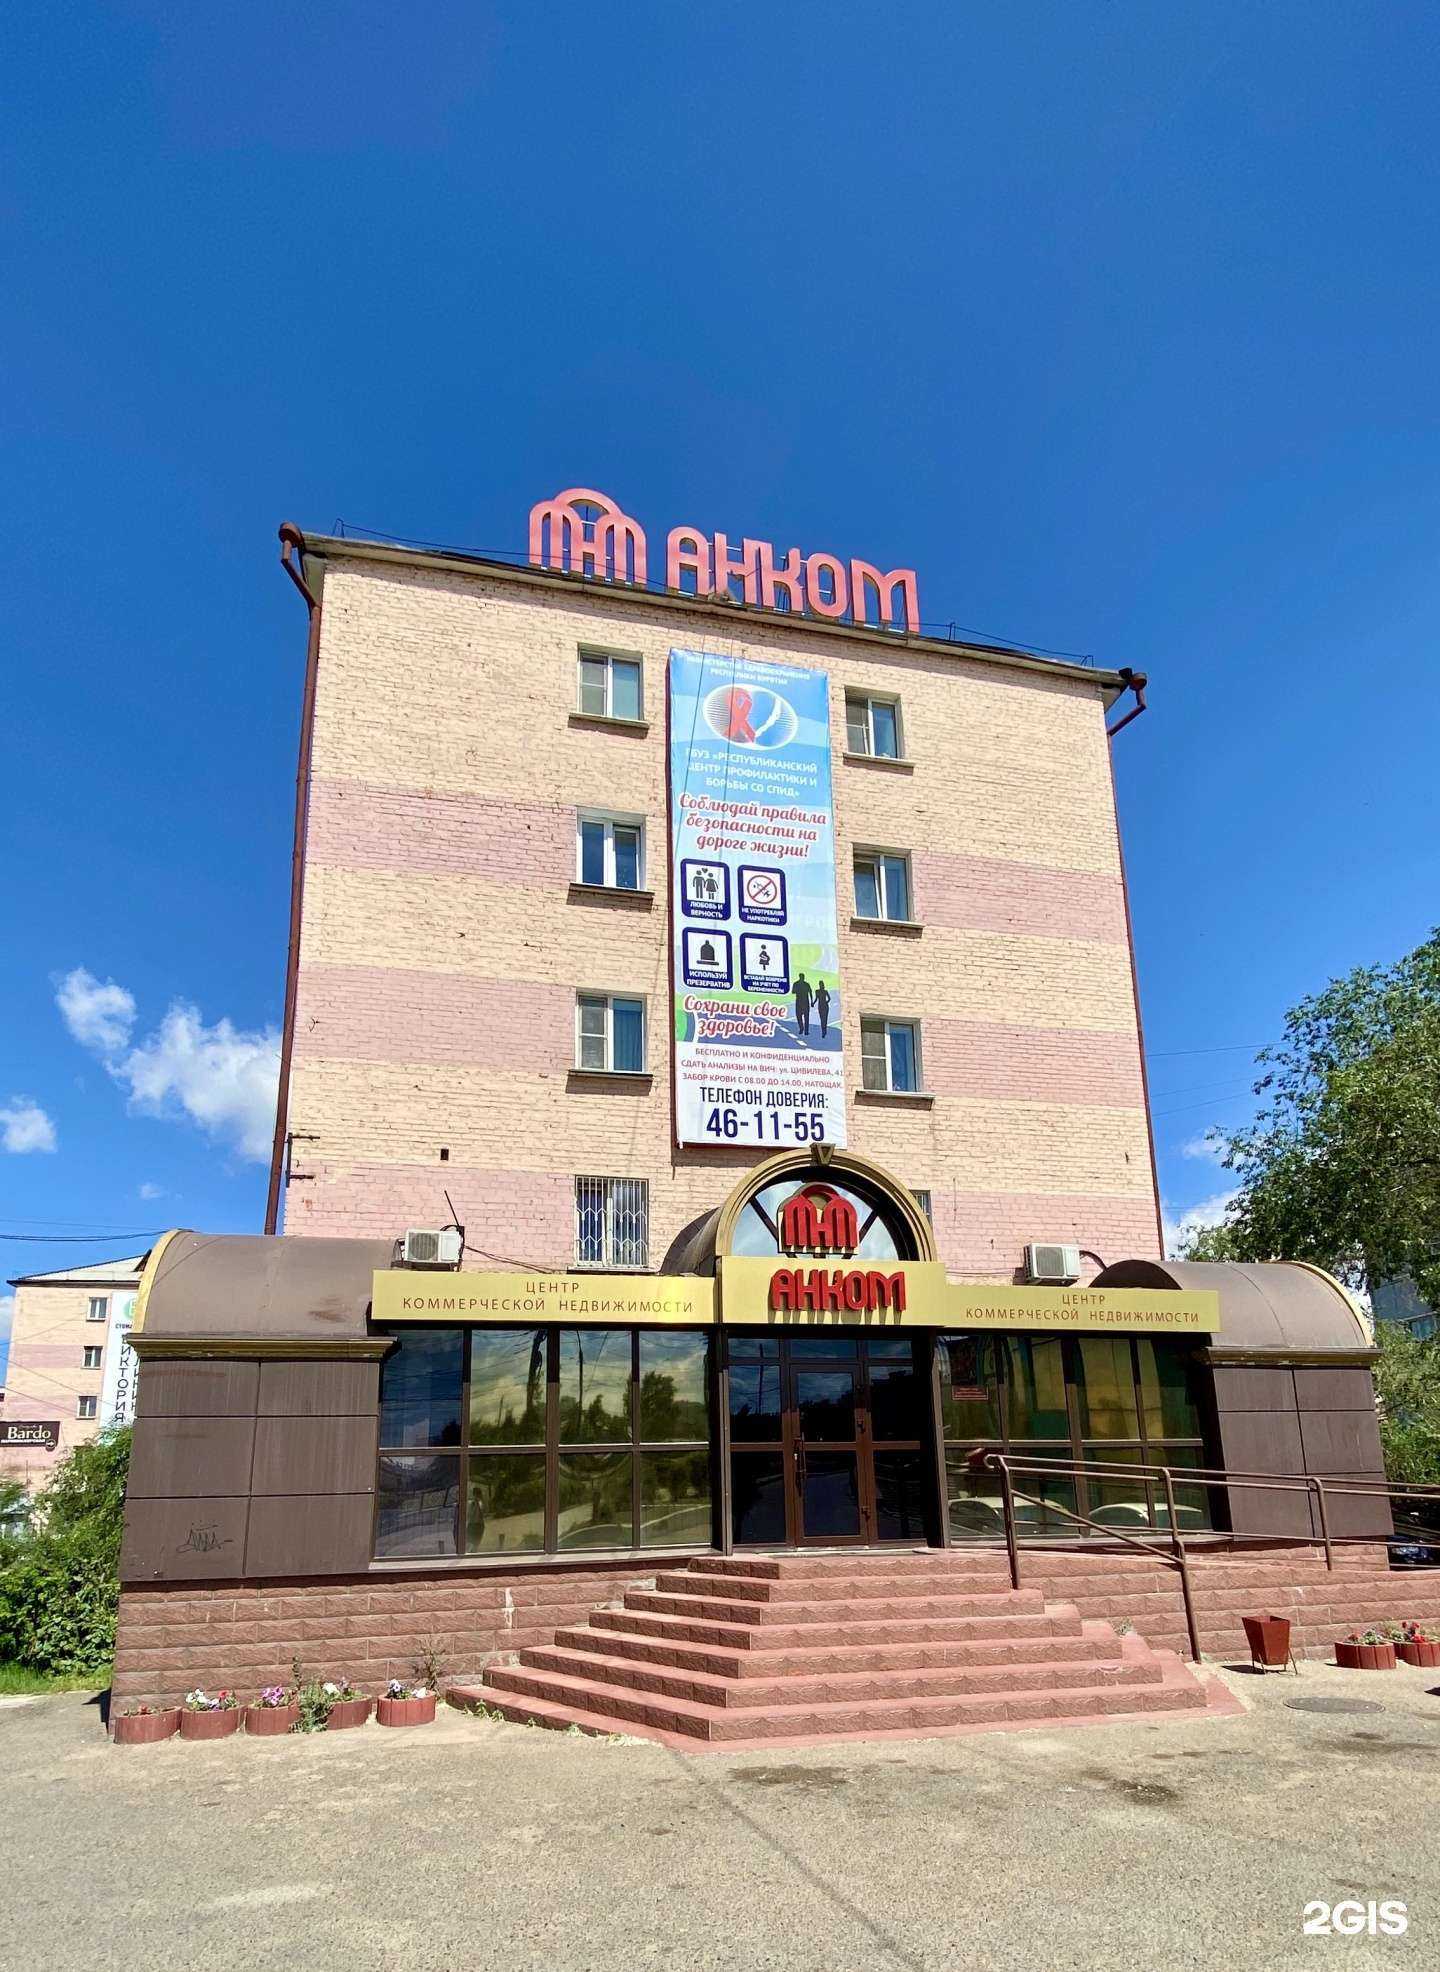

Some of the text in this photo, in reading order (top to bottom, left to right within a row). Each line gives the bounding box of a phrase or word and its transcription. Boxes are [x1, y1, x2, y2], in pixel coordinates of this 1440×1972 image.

[666, 526, 920, 633] АНКОМ
[705, 777, 748, 790] БОРЬБЫ
[751, 782, 764, 793] СО
[723, 766, 807, 785] ПРОФИЛАКТИКИ
[809, 779, 817, 788] И
[680, 793, 826, 825] Соблюдай правила
[686, 812, 817, 841] безопасности на
[696, 834, 809, 859] дороге жизни!
[690, 901, 717, 910] ЛЮБОВЬ
[690, 909, 723, 918] ВЕРНОСТЬ
[689, 970, 728, 980] ИСПОЛЬЗУЙ
[686, 979, 731, 989] ПРЕЗЕРВАТИВ
[684, 995, 786, 1017] Сохрани свое
[698, 1018, 775, 1037] здоровье!
[695, 1047, 741, 1058] БЕСПЛАТНО
[750, 1051, 830, 1063] КОНФИДЕНЦИАЛЬНО
[681, 1060, 706, 1068] СДАТЬ
[707, 1062, 746, 1070] АНАЛИЗЫ
[682, 1073, 708, 1081] ЗАБОР
[710, 1074, 736, 1083] КРОВИ
[744, 1077, 766, 1085] 08.00
[767, 1078, 779, 1086] ДО
[699, 1086, 829, 1109] ТЕЛЕФОН ДОВЕРИЯ:
[706, 1107, 825, 1142] 46-11-55
[525, 1281, 581, 1295] ЦЕНТР
[770, 1268, 907, 1312] АНКОМ
[402, 1297, 694, 1314] КОММЕРЧЕСКОЙ НЕДВИЖИМОСТИ
[1061, 1294, 1106, 1307] ЦЕНТР
[965, 1308, 1200, 1323] КОММЕРЧЕСКОЙ НЕДВИЖИМОСТИ
[7, 1424, 52, 1439] Bardo
